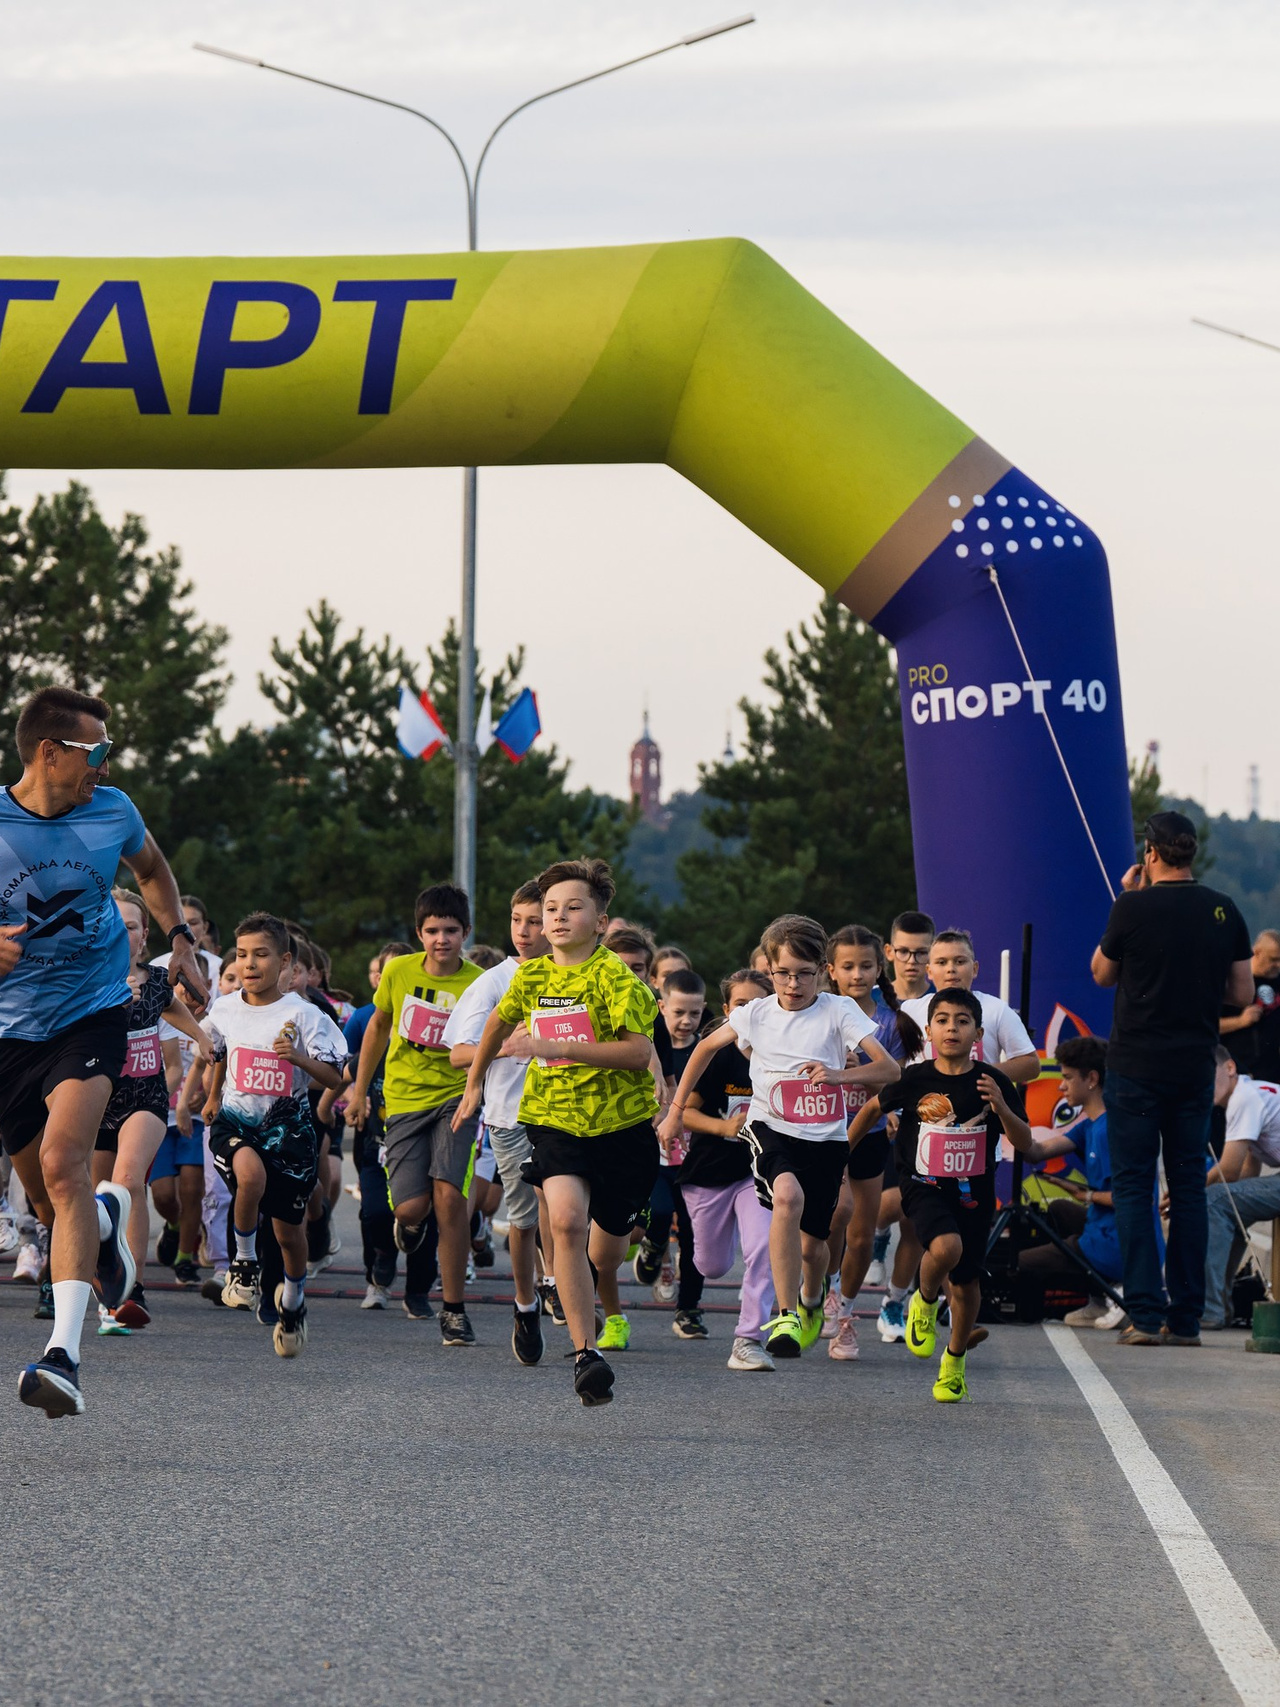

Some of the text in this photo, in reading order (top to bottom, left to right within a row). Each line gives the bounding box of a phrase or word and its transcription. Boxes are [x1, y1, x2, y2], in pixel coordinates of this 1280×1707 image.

[908, 663, 948, 688] PRO
[911, 679, 1107, 725] СПОРТ 40
[539, 998, 560, 1006] FREE
[420, 1025, 444, 1045] 41
[554, 1022, 573, 1034] ГЛЕБ
[131, 1039, 154, 1050] МАРИНА
[130, 1050, 157, 1072] 759
[252, 1056, 279, 1069] ДАВИД
[243, 1067, 286, 1092] 3203
[803, 1083, 823, 1093] ОЛЕГ
[793, 1093, 837, 1117] 4667
[944, 1139, 976, 1150] АРСЕНИЙ
[943, 1152, 976, 1173] 907
